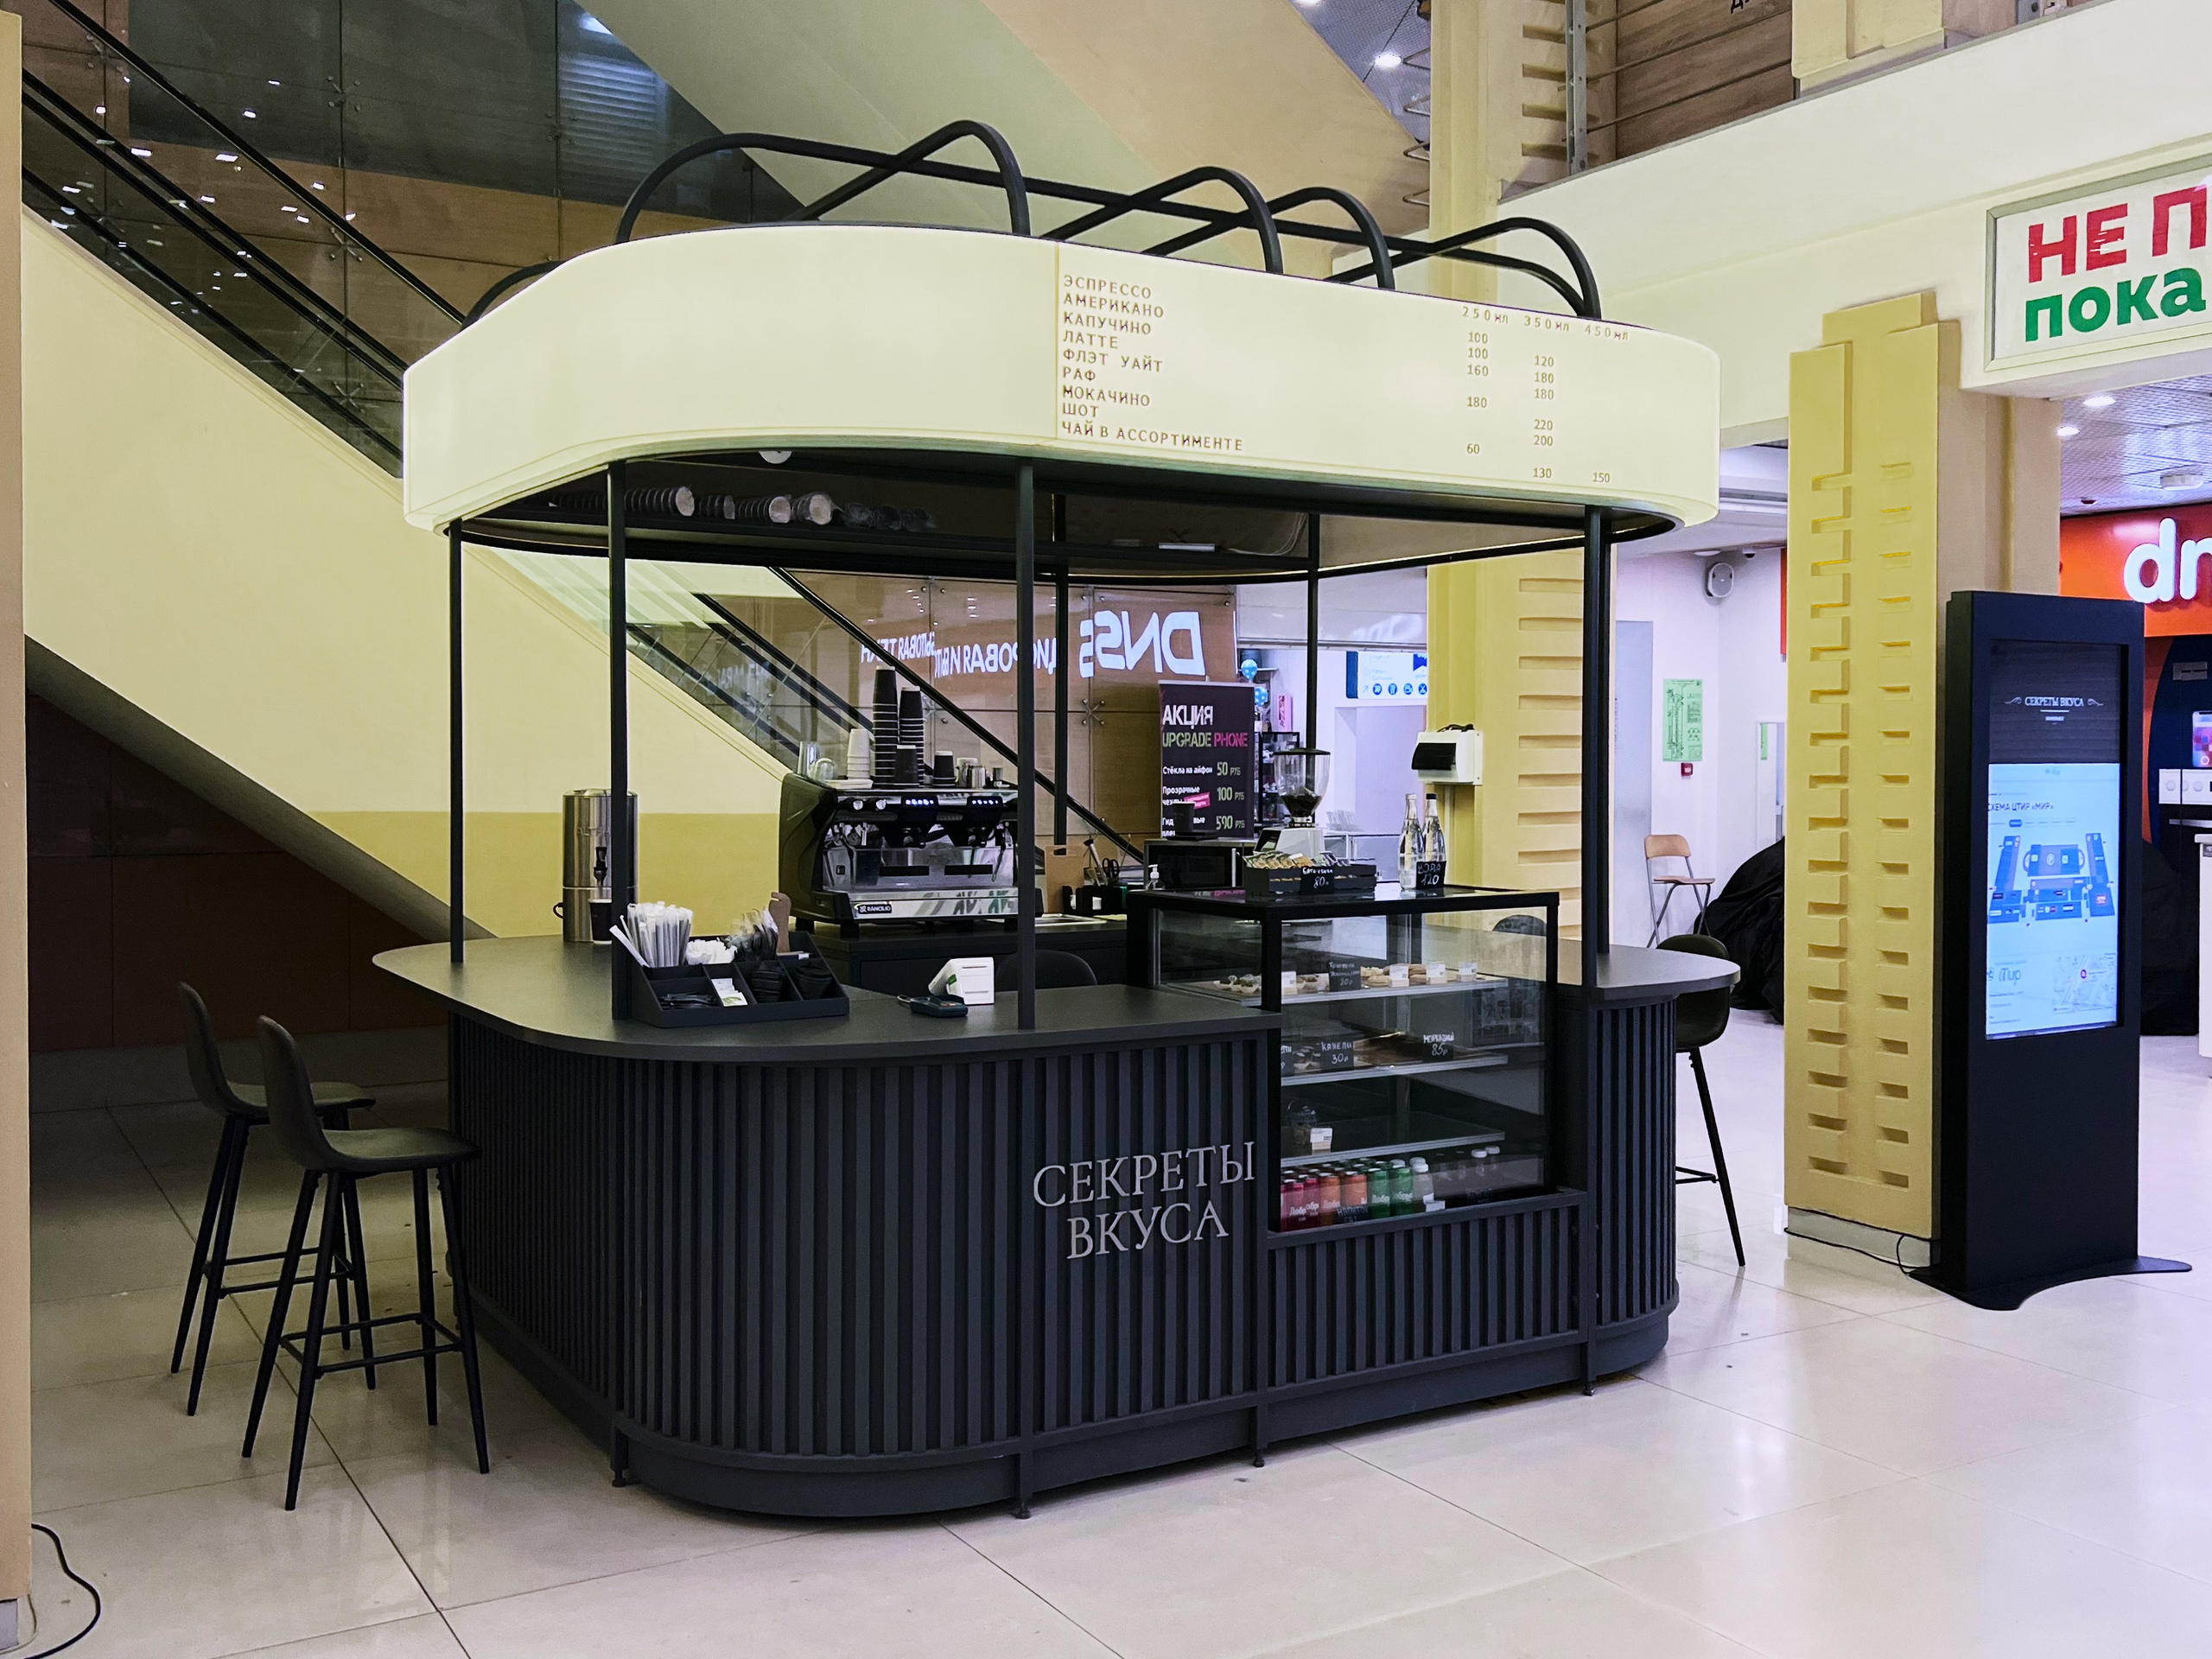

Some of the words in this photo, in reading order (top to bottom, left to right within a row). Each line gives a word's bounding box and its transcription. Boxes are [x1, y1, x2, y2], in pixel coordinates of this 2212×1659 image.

[2028, 203, 2127, 283] НЕ
[1064, 275, 1151, 299] ЭСПРЕССО
[1064, 293, 1164, 318] АМЕРИКАНО
[2025, 267, 2206, 342] пока
[1064, 312, 1151, 334] КАПУЧИНО
[1063, 330, 1118, 349] ЛАТТЕ
[1467, 332, 1488, 344] 100
[1063, 348, 1108, 365] ФЛЭТ
[1121, 354, 1163, 372] УАЙТ
[1467, 346, 1488, 359] 100
[1534, 355, 1554, 367] 120
[1063, 366, 1096, 381] РАФ
[1467, 365, 1489, 377] 160
[1534, 372, 1554, 384] 180
[1062, 385, 1150, 407] МОКАЧИНО
[1534, 388, 1554, 400] 180
[1062, 403, 1098, 417] ШОТ
[1467, 397, 1487, 409] 180
[1533, 419, 1554, 431] 220
[1062, 420, 1093, 436] ЧАЙ
[1101, 425, 1109, 437] В
[1116, 428, 1243, 451] АССОРТИМЕНТЕ
[1534, 435, 1554, 447] 200
[1467, 443, 1480, 454] 60
[1532, 467, 1552, 479] 130
[1592, 472, 1611, 483] 150
[1162, 705, 1214, 729] АКЦИЯ
[1162, 732, 1211, 747] UPGRADE
[1213, 732, 1248, 747] PHONE
[1163, 766, 1185, 775] Стёкла
[1217, 761, 1229, 776] 50
[1230, 767, 1241, 776] РУБ
[1217, 787, 1233, 801] 100
[1235, 791, 1244, 800] РУБ
[1216, 816, 1233, 830] 590
[1235, 820, 1245, 829] РУБ
[1421, 874, 1440, 886] 120
[1033, 1141, 1255, 1207] СЕКРЕТЫ
[1066, 1199, 1229, 1259] ВКУСА
